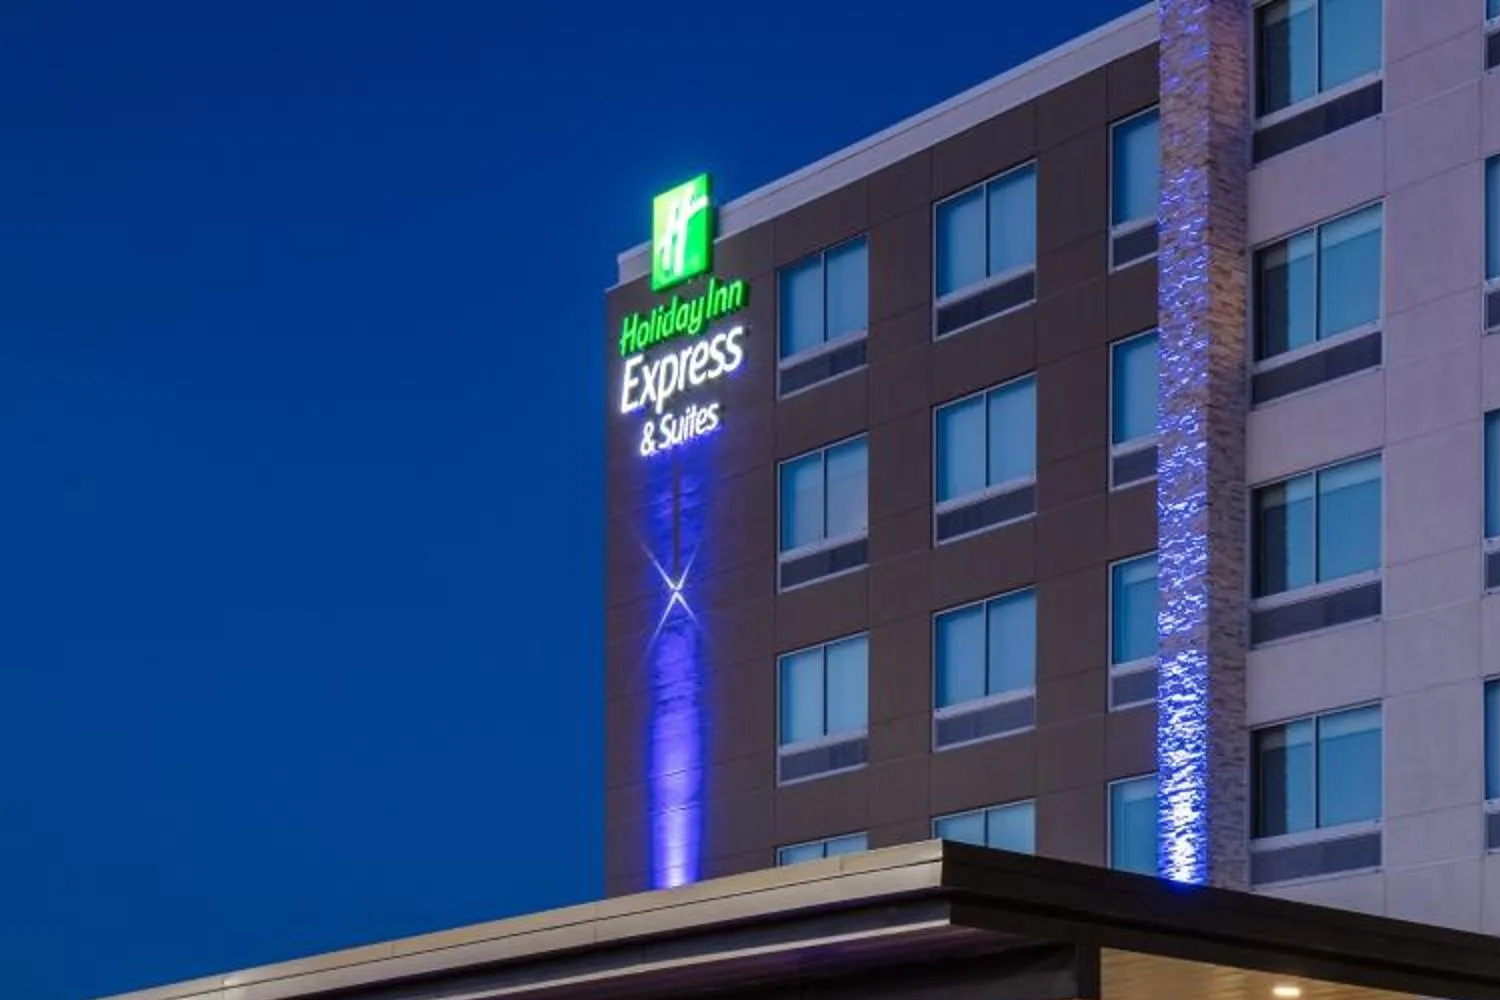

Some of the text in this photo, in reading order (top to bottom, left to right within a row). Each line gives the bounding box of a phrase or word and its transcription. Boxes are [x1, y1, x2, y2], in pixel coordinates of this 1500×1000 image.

[620, 278, 743, 356] Holiday Inn
[621, 326, 743, 414] Express
[641, 403, 719, 456] & Suites
